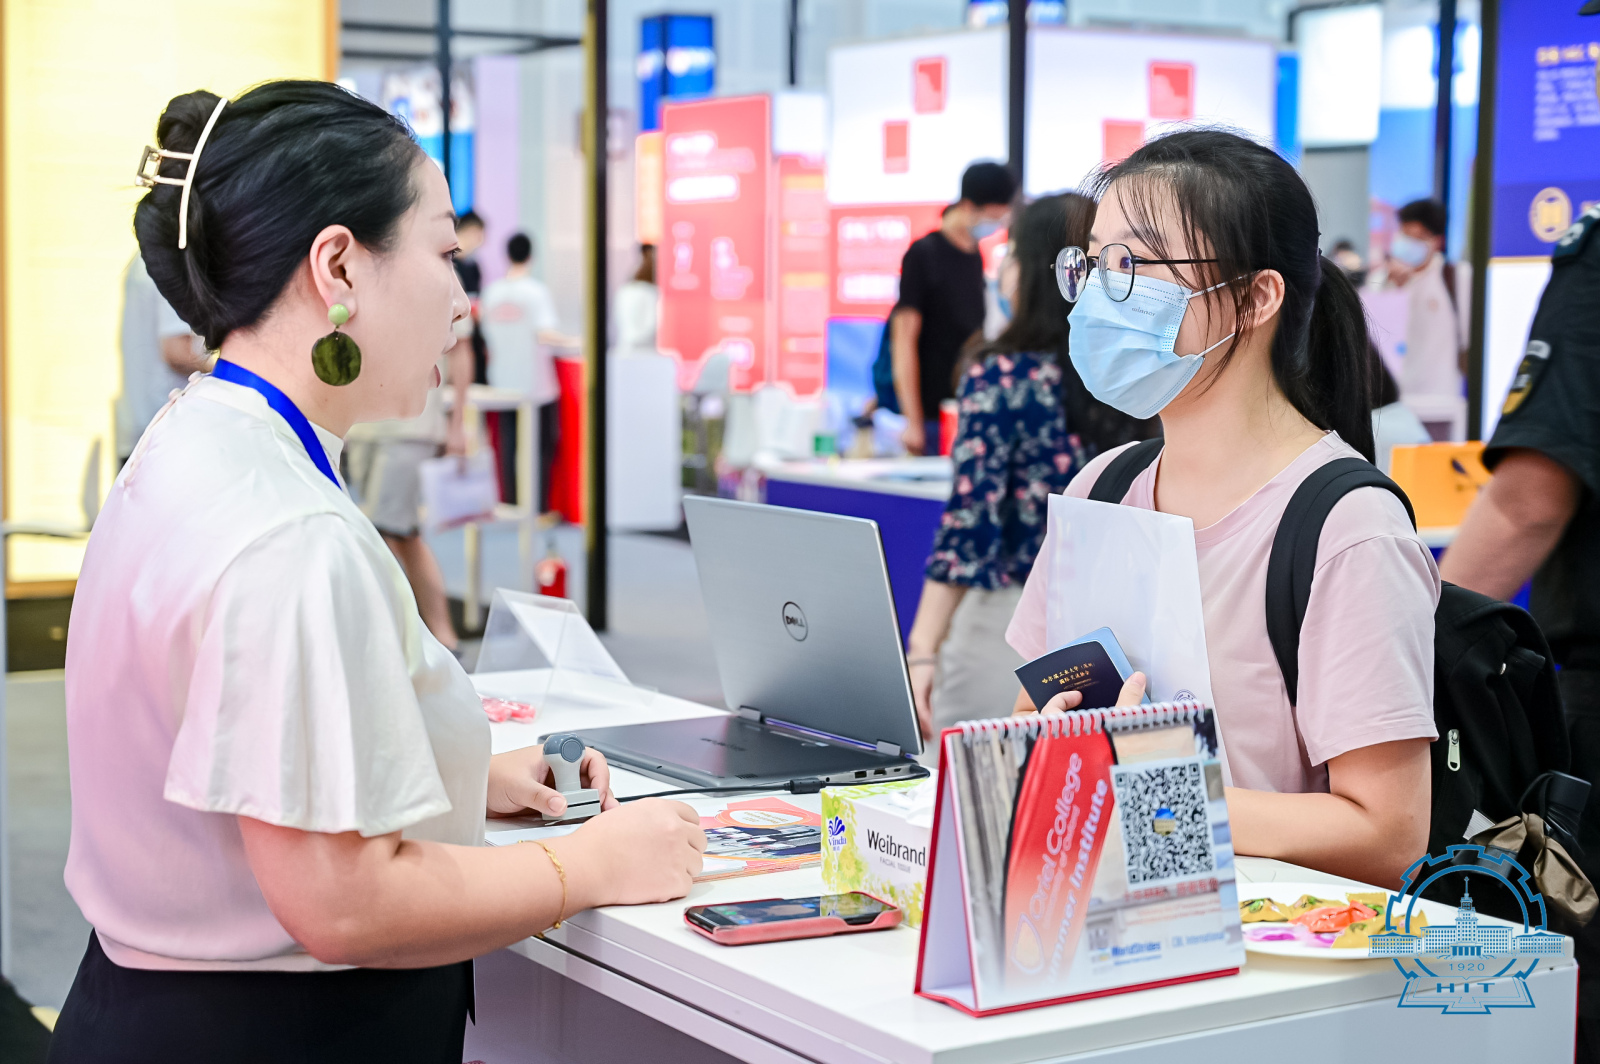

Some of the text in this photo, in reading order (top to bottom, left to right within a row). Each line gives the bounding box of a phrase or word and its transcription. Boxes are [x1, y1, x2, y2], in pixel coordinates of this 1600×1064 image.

[785, 615, 805, 628] DELL
[867, 829, 925, 867] Weibrand
[1030, 753, 1082, 921] Oriel College
[1048, 779, 1108, 984] ummer Institute
